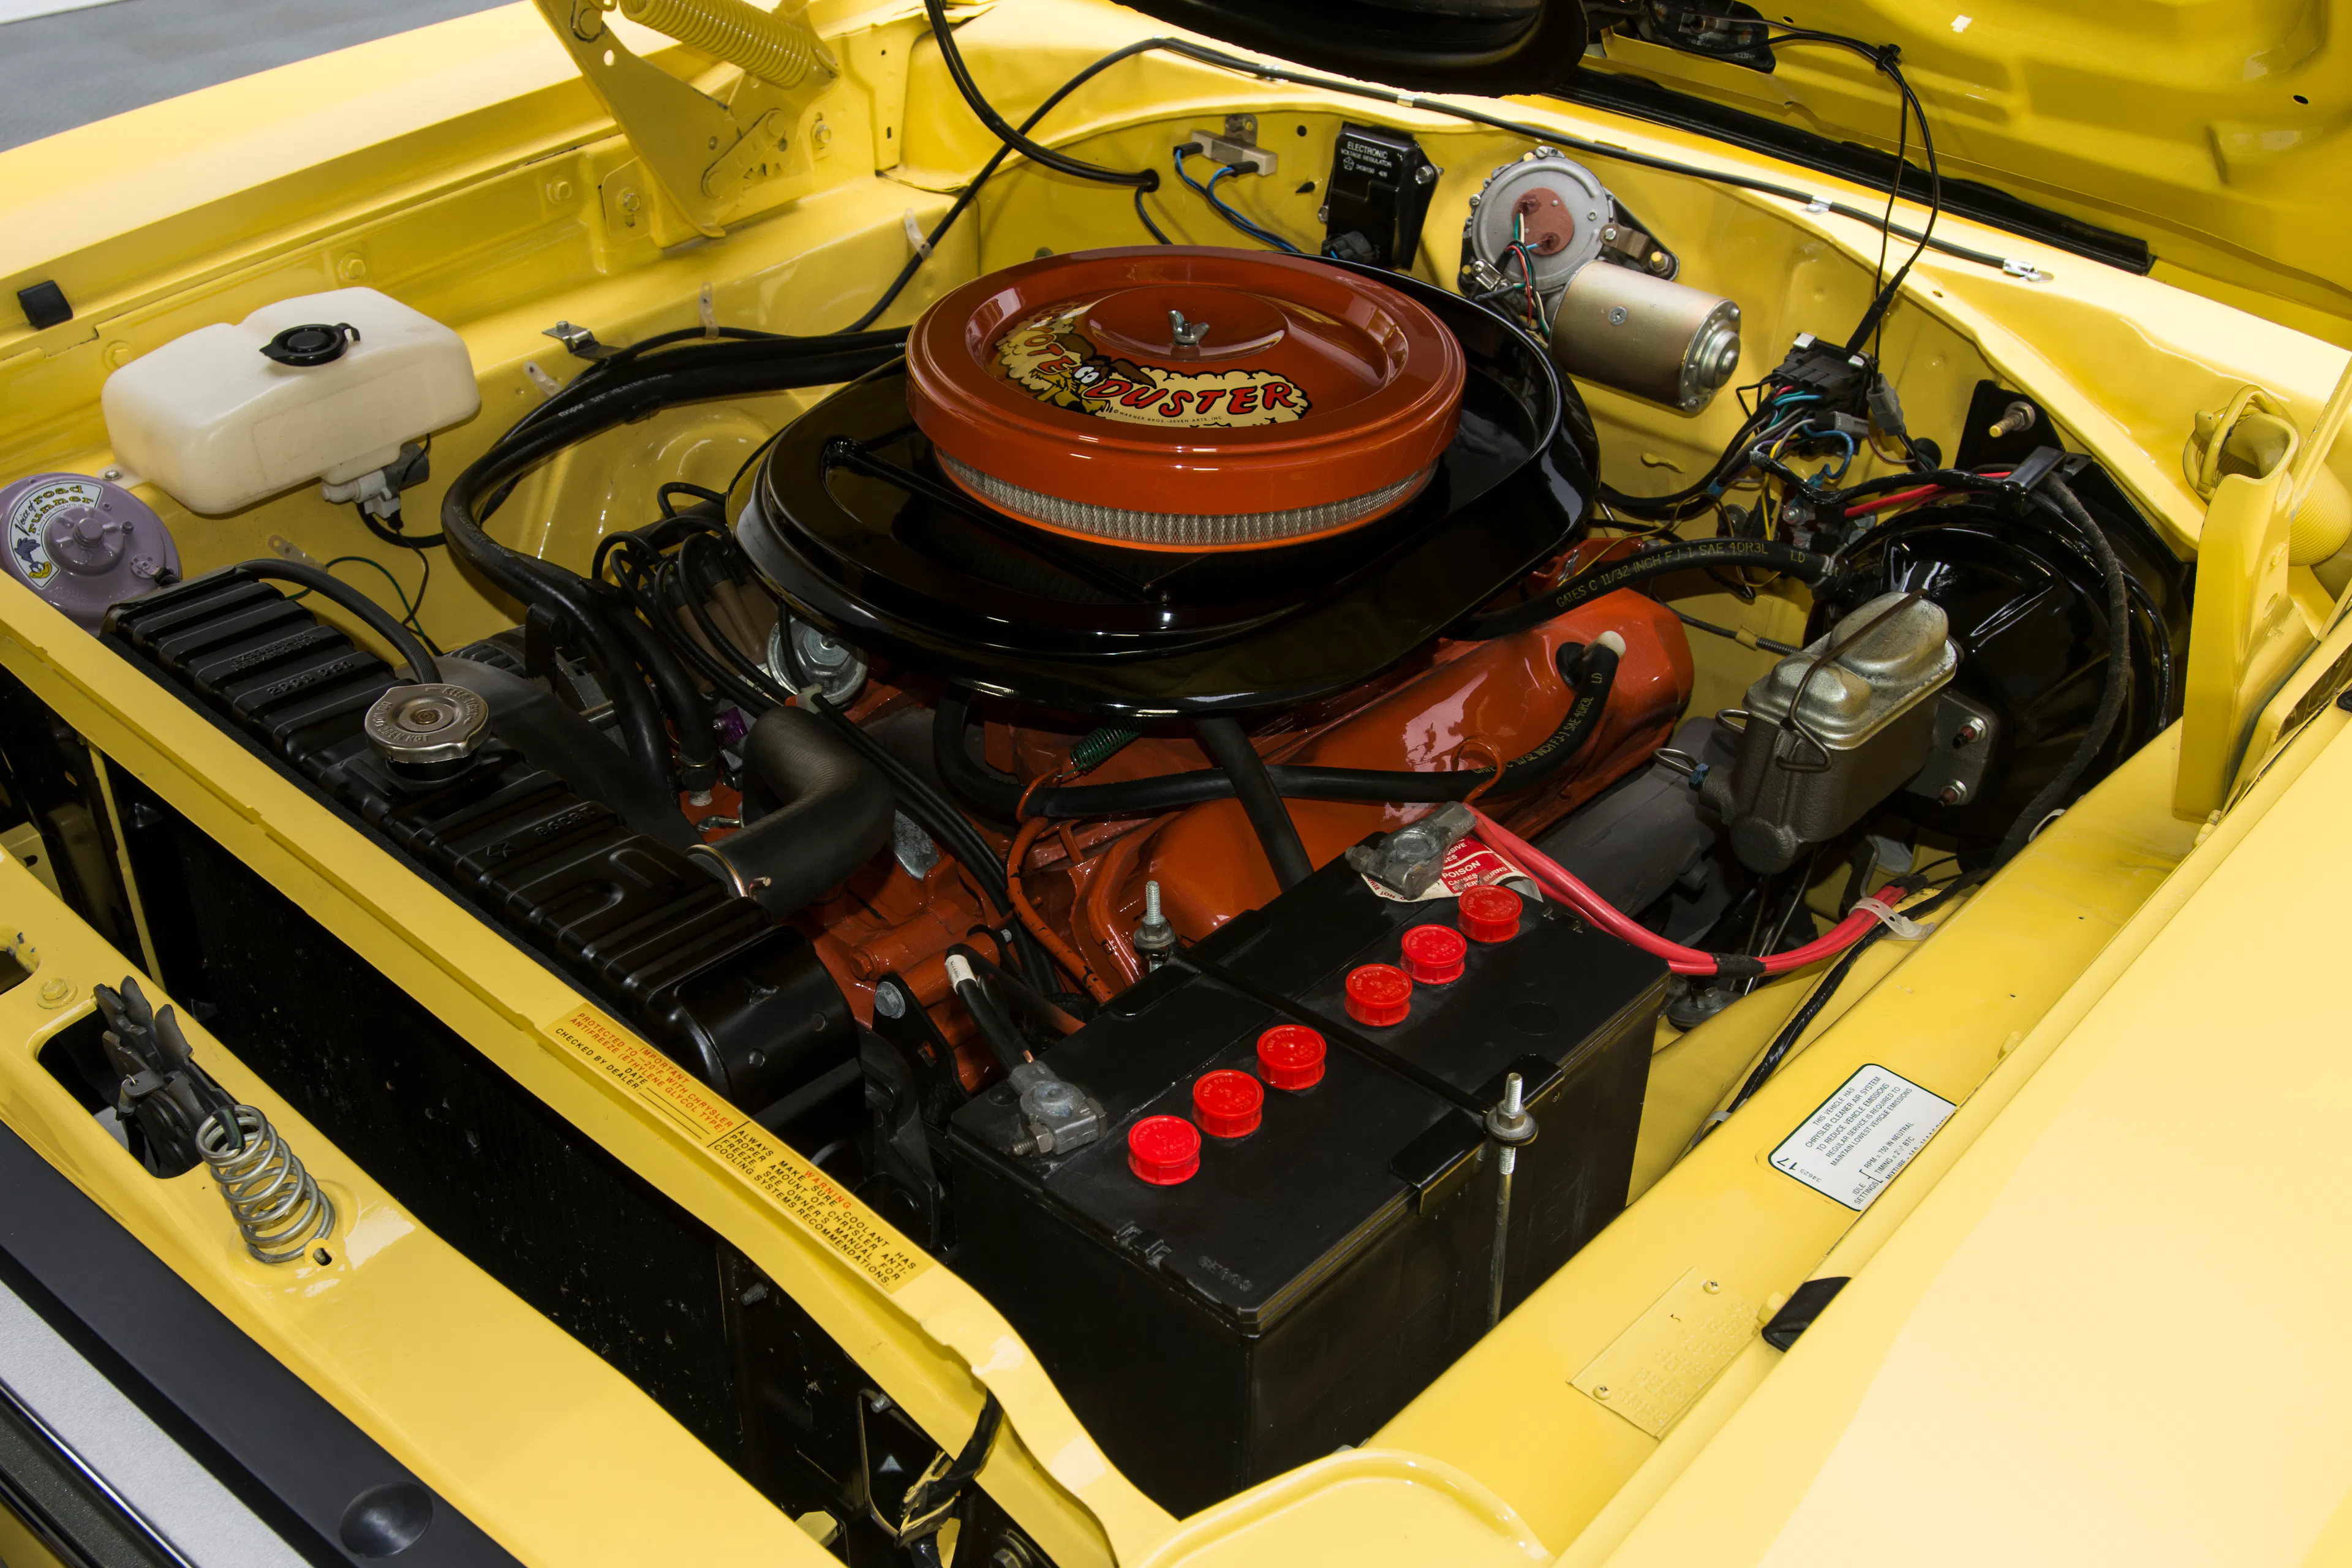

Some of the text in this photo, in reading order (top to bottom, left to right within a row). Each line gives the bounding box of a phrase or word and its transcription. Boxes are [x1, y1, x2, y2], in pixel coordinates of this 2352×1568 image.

[1341, 148, 1392, 168] VOLTAGE REGULATOR
[1348, 141, 1388, 159] ELECTRONIC
[558, 403, 584, 418] mopar
[1082, 378, 1298, 418] DUSTER
[28, 496, 94, 534] runner
[33, 485, 84, 505] road
[15, 500, 37, 537] Voice of
[1556, 585, 1587, 608] GATES
[1589, 579, 1598, 591] C
[1600, 565, 1629, 587] 11/32
[1634, 554, 1662, 574] INCH
[1699, 543, 1724, 556] SAE
[1730, 542, 1769, 554] 40R3L
[1790, 550, 1805, 563] LD
[1564, 718, 1582, 731] SAE
[1574, 696, 1594, 717] 40R3L
[1591, 673, 1603, 684] LD
[1442, 860, 1481, 878] POISON
[1452, 867, 1508, 891] SVER BURNS
[556, 1028, 642, 1091] CHECKED BY DEALER:
[569, 1018, 725, 1133] ANTIFREEZE (ETHYLENE GLYCOL TYPE)
[577, 1012, 625, 1047] PROTECTED
[625, 1047, 638, 1057] TO
[666, 1077, 688, 1094] WITH
[688, 1093, 734, 1128] CHRYSLER
[624, 1068, 648, 1085] DATE
[639, 1047, 690, 1084] IMPORTANT
[1805, 1076, 1882, 1148] CHRYSLER CLEANER AIR SYSTEM
[1812, 1087, 1855, 1126] THIS VEHICLE HAS
[1815, 1083, 1890, 1152] TO REDUCE VEHICLE EMISSIONS
[1825, 1135, 1850, 1158] REGULAR
[1847, 1118, 1868, 1137] SERVICE
[1869, 1094, 1894, 1115] REQUIRED
[1891, 1087, 1901, 1095] TO
[1830, 1087, 1913, 1166] MAINTAIN LOWEST VEHICLE EMISSIONS
[1864, 1156, 1878, 1169] RPM
[1878, 1145, 1889, 1155] 750
[1891, 1122, 1915, 1143] NEUTRAL
[1874, 1158, 1893, 1175] TIMING
[1902, 1136, 1915, 1147] BTC
[729, 1134, 908, 1275] PROPER AMOUNT OF CHRYSLER ANTI-
[737, 1130, 917, 1270] ALWAYS MAKE SURE COOLANT HAS
[804, 1170, 853, 1210] WARNING
[1852, 1183, 1866, 1195] IDLE
[1854, 1181, 1879, 1205] SETTINGS
[714, 1144, 891, 1286] COOLING SYSTEMS RECOMMENDATIONS.
[721, 1139, 901, 1281] FREEZE. SEE OWNER'S MANUAL FOR
